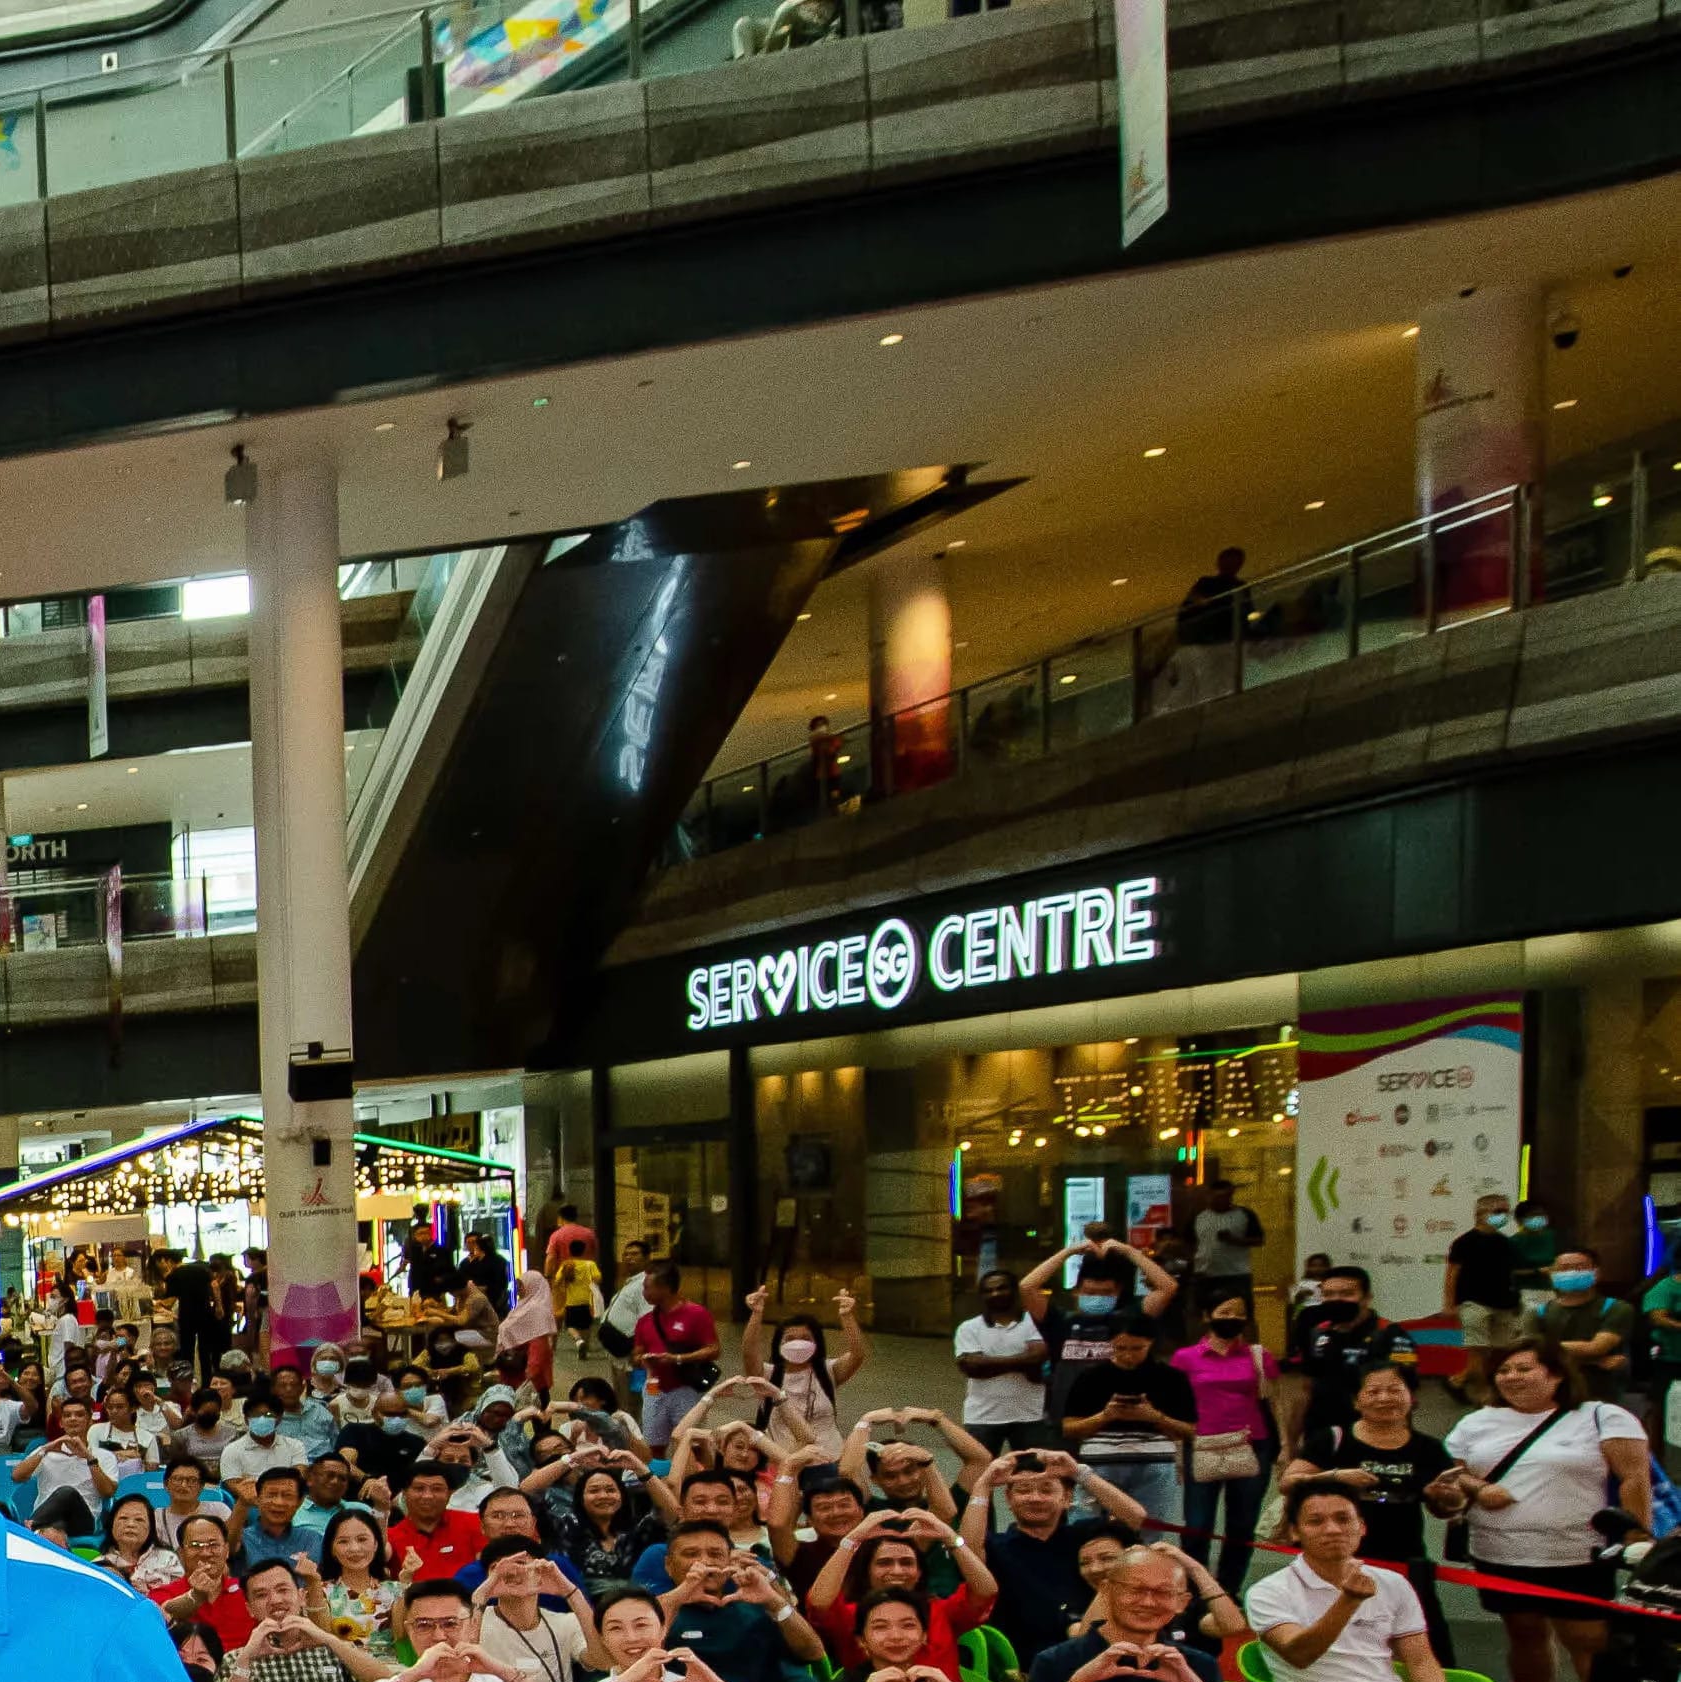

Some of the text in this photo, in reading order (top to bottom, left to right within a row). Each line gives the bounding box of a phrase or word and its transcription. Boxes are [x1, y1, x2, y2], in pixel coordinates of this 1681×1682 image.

[7, 839, 68, 863] ORTH
[688, 936, 866, 1030] SERVICE
[929, 878, 1156, 991] CENTRE
[278, 1210, 297, 1218] OUR
[298, 1207, 341, 1217] TAMPINES
